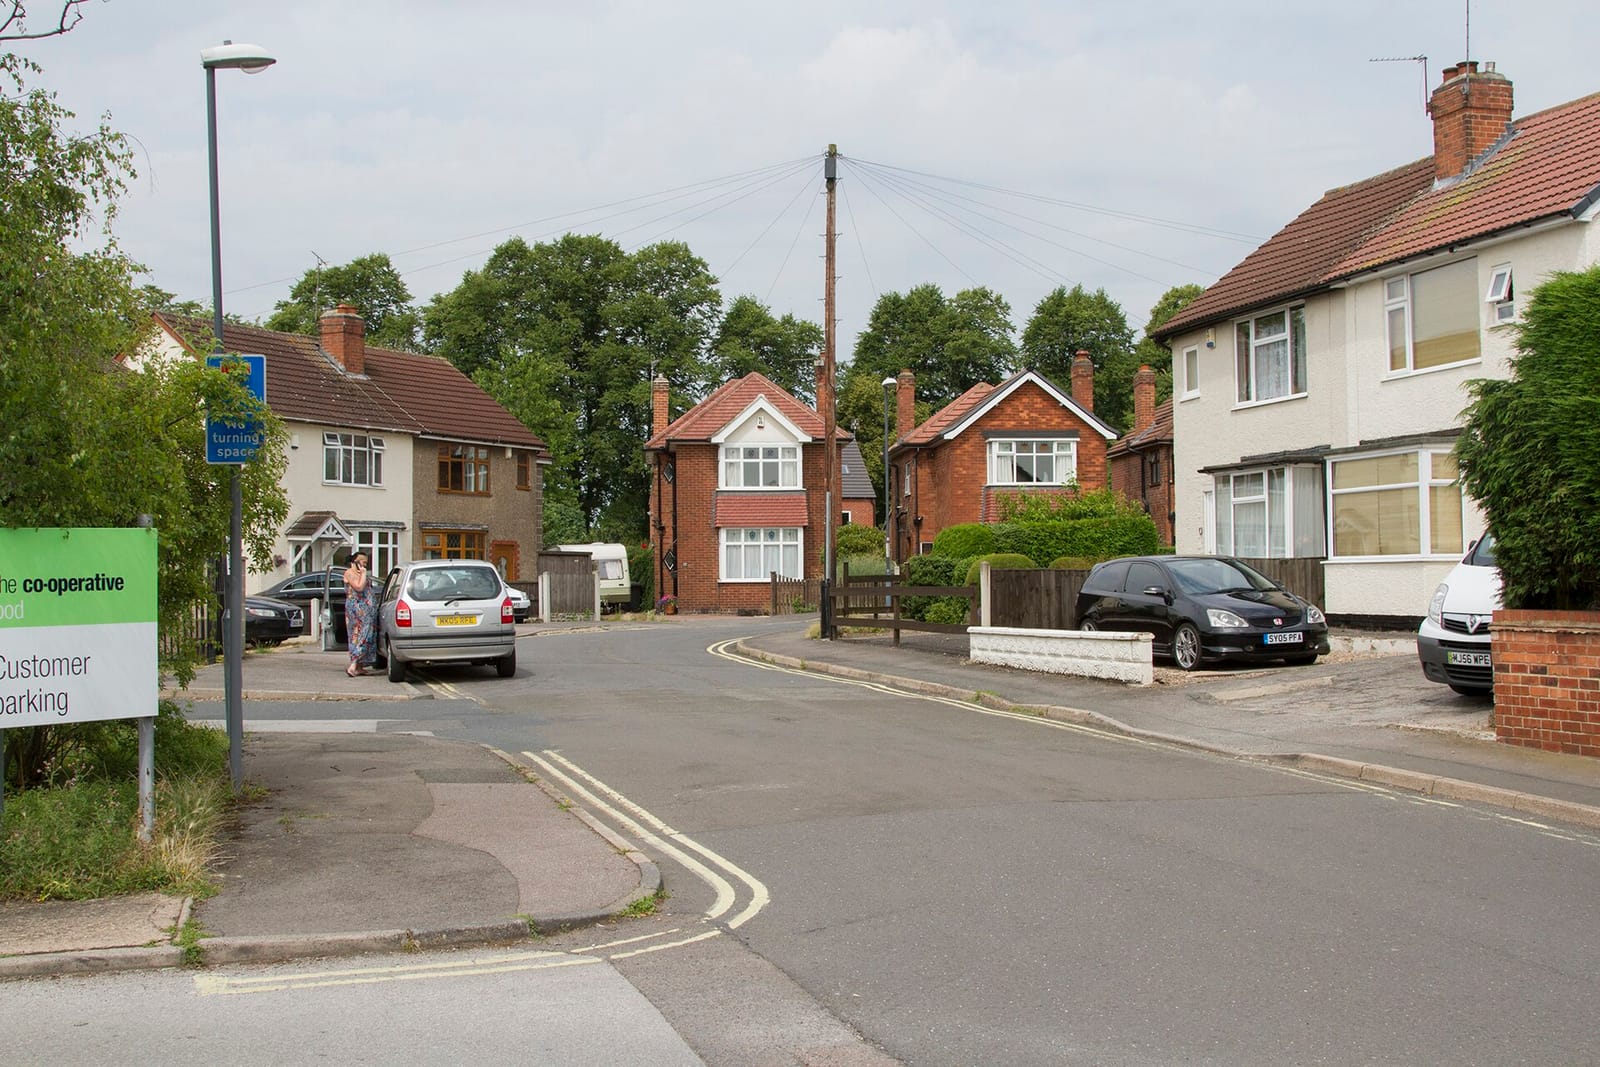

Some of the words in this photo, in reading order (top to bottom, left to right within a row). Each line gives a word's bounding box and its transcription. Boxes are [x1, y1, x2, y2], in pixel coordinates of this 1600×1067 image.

[213, 432, 259, 445] turning
[217, 448, 255, 459] space
[0, 575, 17, 593] he
[23, 573, 125, 596] co-operative
[1269, 633, 1288, 643] SY05
[1289, 632, 1302, 641] PFA
